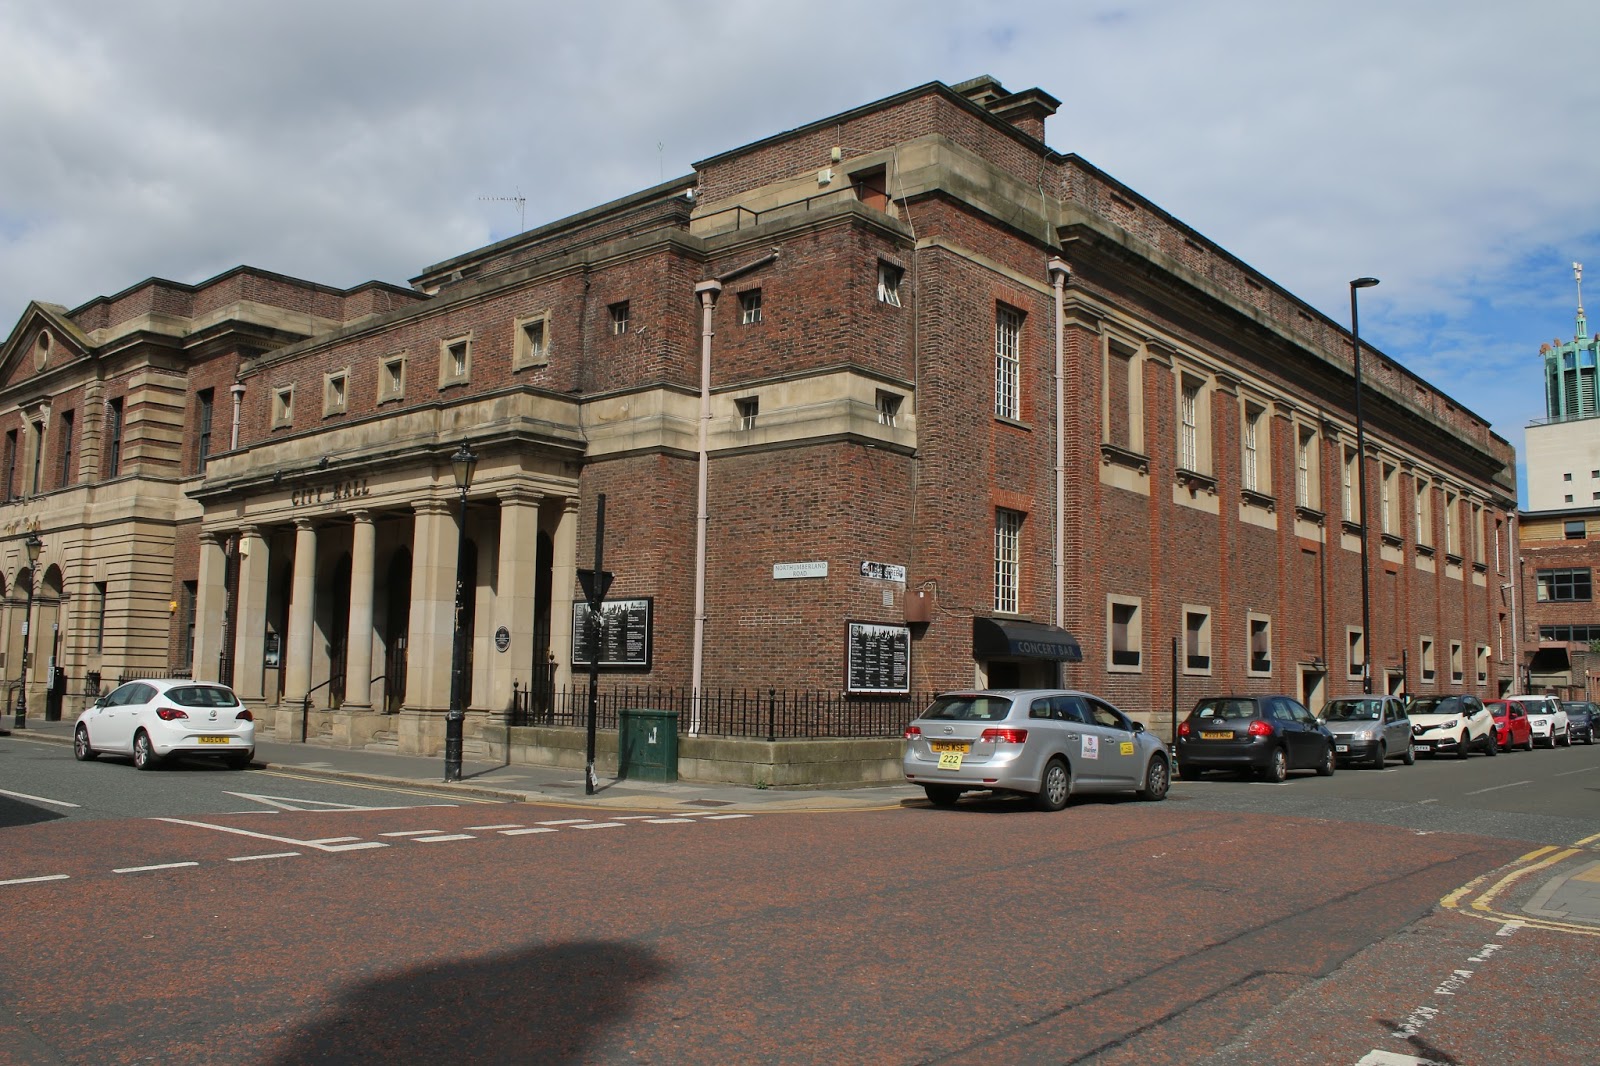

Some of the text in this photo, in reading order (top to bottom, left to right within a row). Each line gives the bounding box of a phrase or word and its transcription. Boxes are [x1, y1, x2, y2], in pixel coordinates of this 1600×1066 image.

[291, 479, 370, 506] CITY HALL
[775, 563, 826, 571] NORTHUMBERLAND
[1018, 641, 1075, 656] CONCERT BAR
[943, 755, 959, 764] 222
